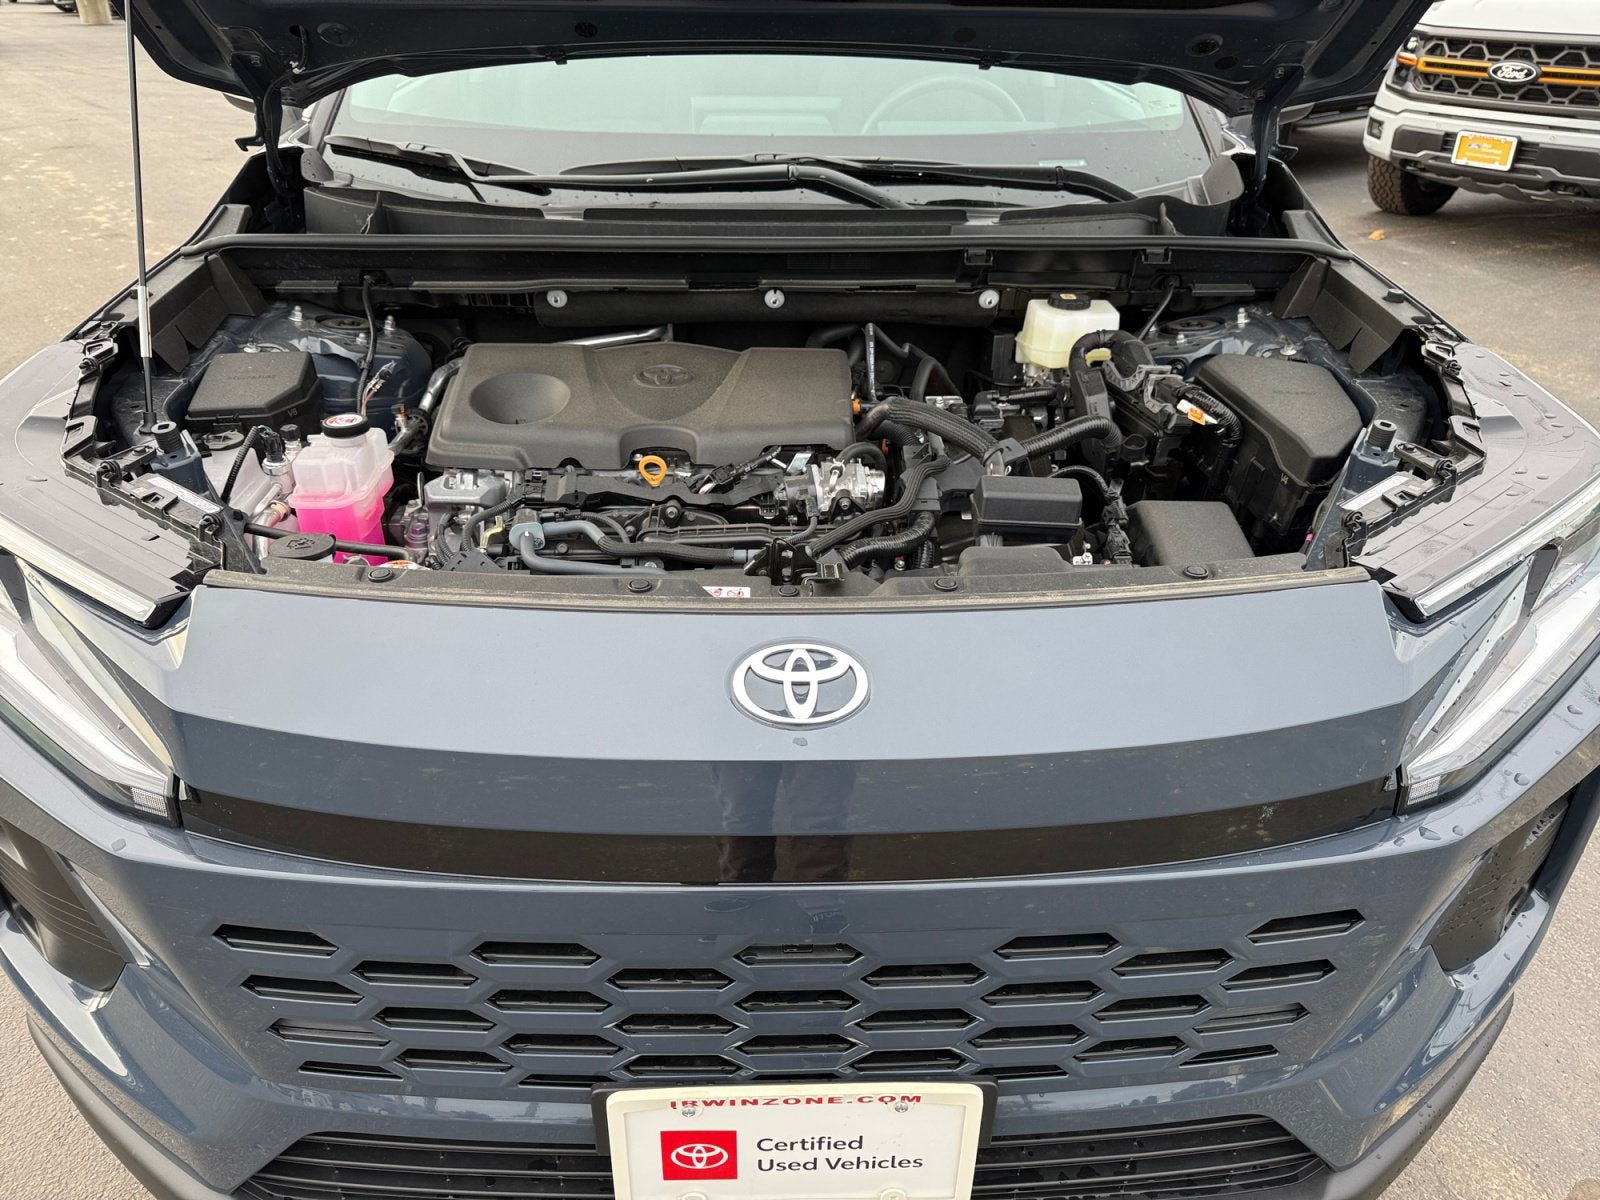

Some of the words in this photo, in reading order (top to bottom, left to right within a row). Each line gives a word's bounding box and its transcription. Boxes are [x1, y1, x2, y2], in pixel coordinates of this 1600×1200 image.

[1497, 64, 1528, 79] Ford
[670, 1095, 921, 1109] IRWINZONE.COM
[757, 1135, 863, 1152] Certified
[757, 1157, 818, 1172] Used
[825, 1155, 923, 1170] Vehicles
